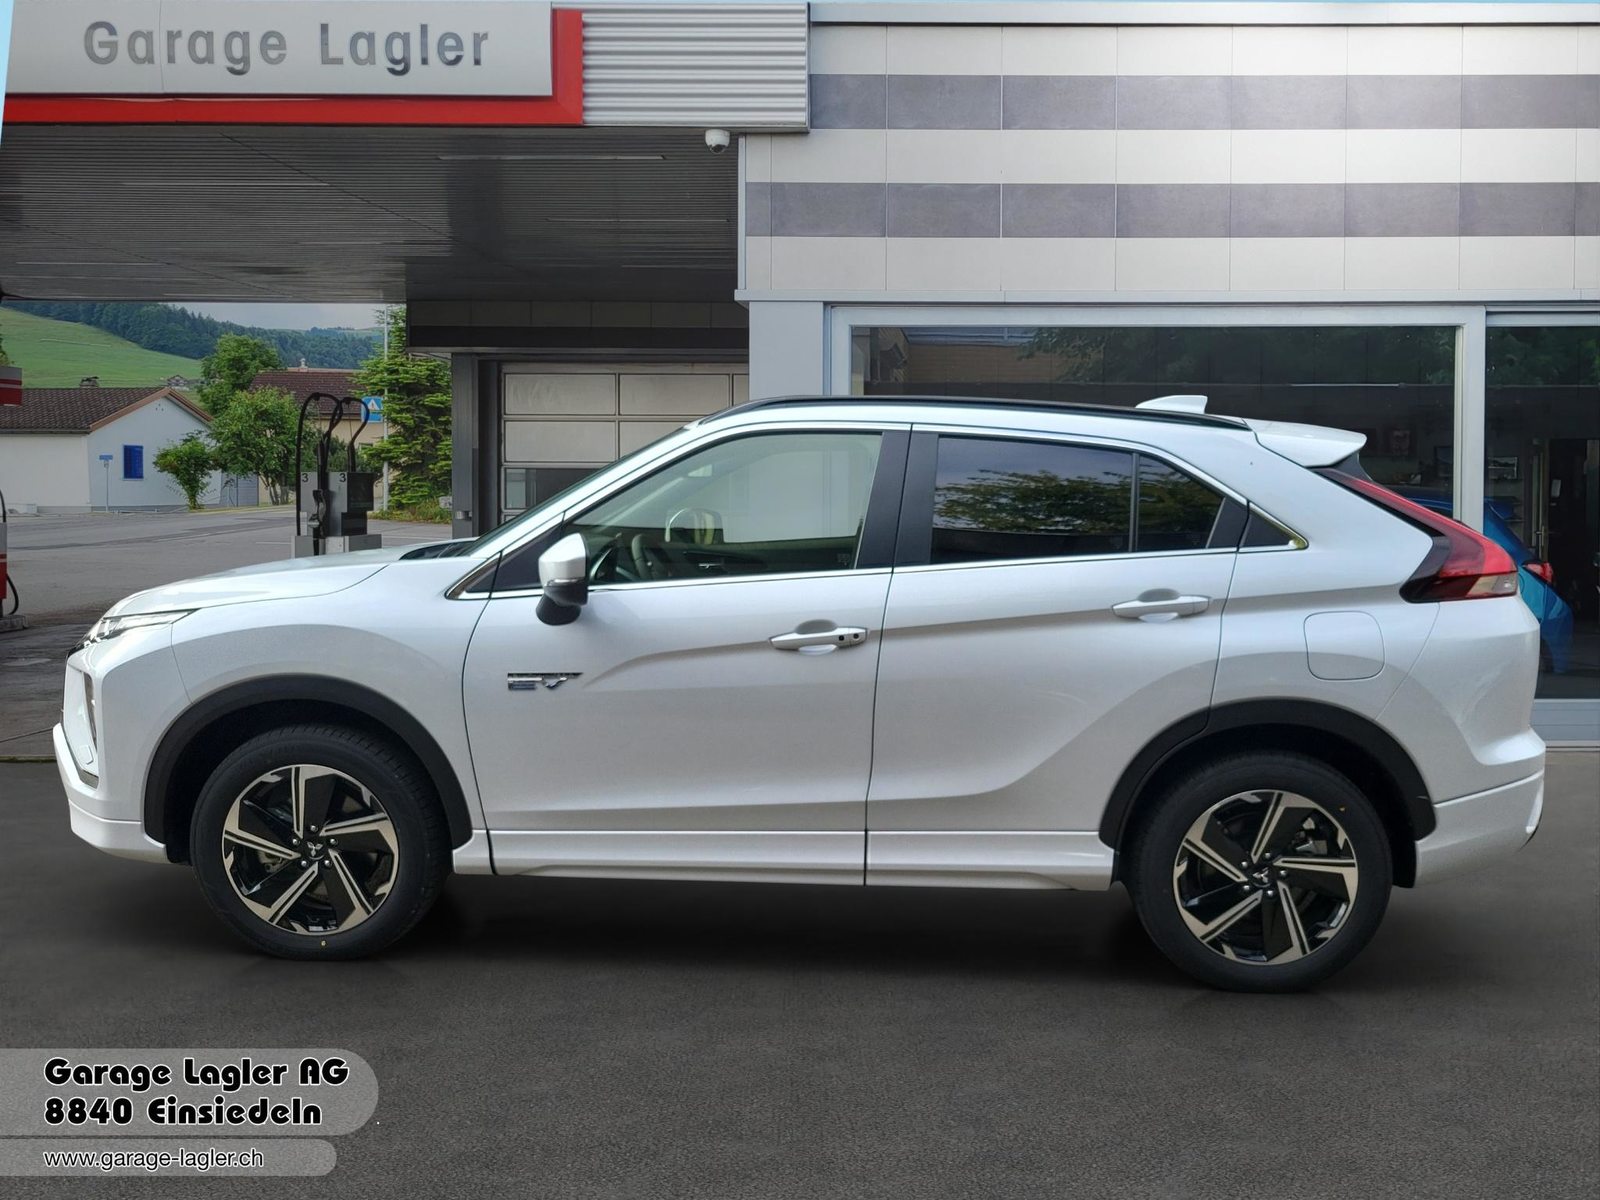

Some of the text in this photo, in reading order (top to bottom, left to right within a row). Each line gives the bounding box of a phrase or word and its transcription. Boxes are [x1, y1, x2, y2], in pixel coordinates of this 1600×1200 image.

[83, 20, 490, 77] Garage Lagler
[302, 473, 309, 483] 3
[339, 473, 347, 483] 3
